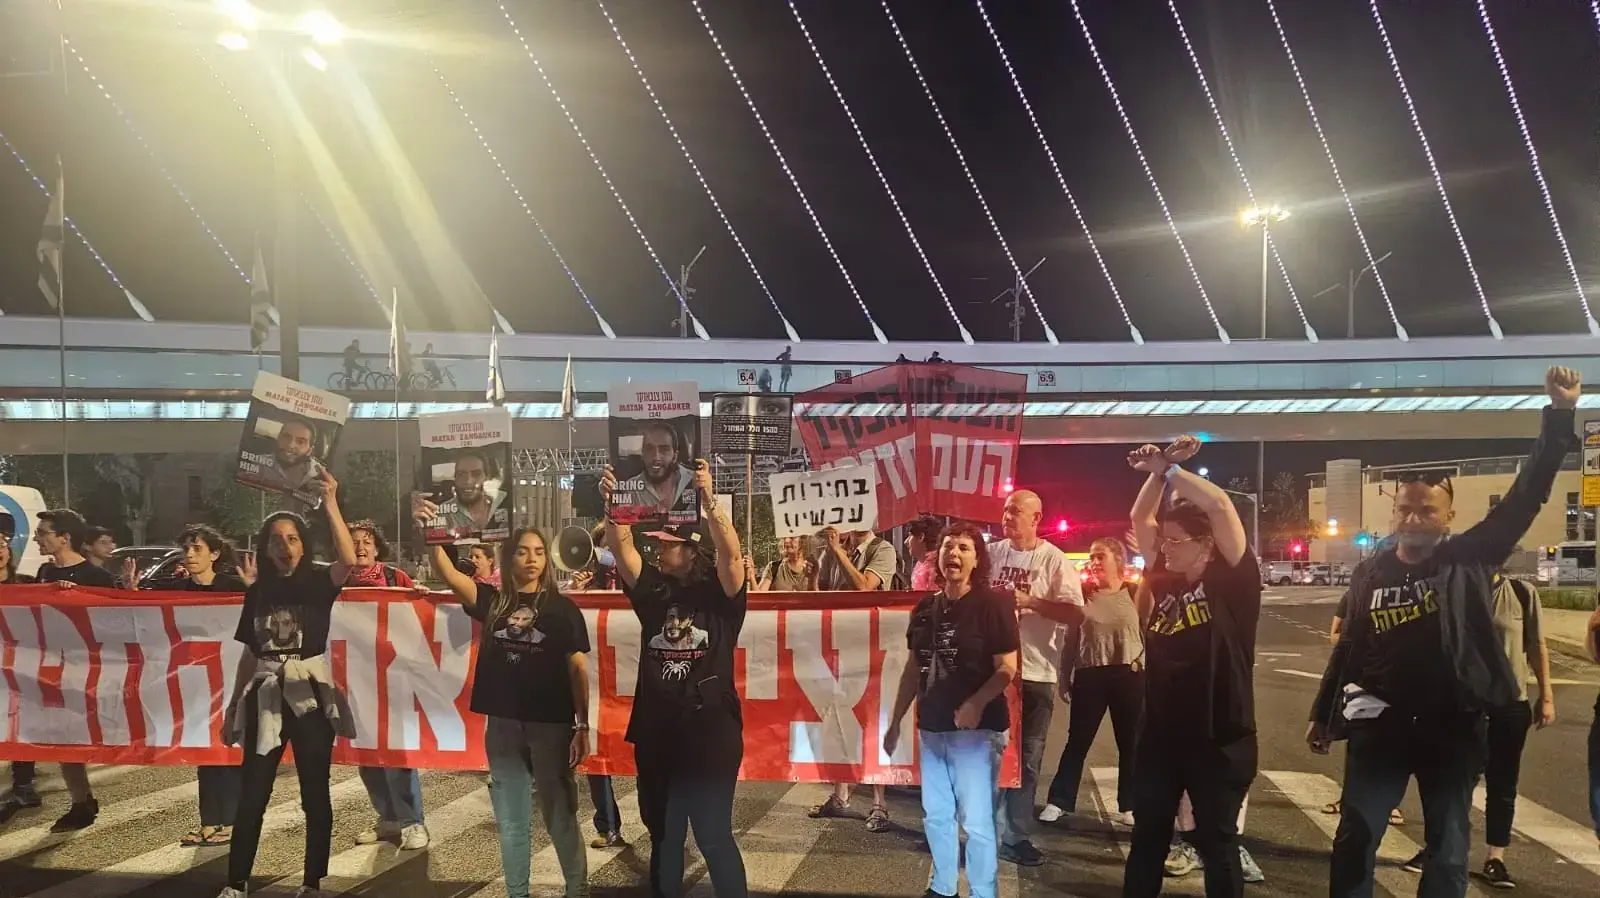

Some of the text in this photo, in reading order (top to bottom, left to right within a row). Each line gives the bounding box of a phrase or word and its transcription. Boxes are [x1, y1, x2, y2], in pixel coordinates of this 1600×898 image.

[740, 372, 754, 382] 6.4
[241, 451, 273, 467] BRING
[930, 432, 1013, 498] העם
[240, 461, 259, 473] HIM
[612, 480, 644, 491] BRING
[778, 478, 869, 504] בחירות
[612, 493, 633, 504] HIM
[784, 504, 864, 534] עכשיו!
